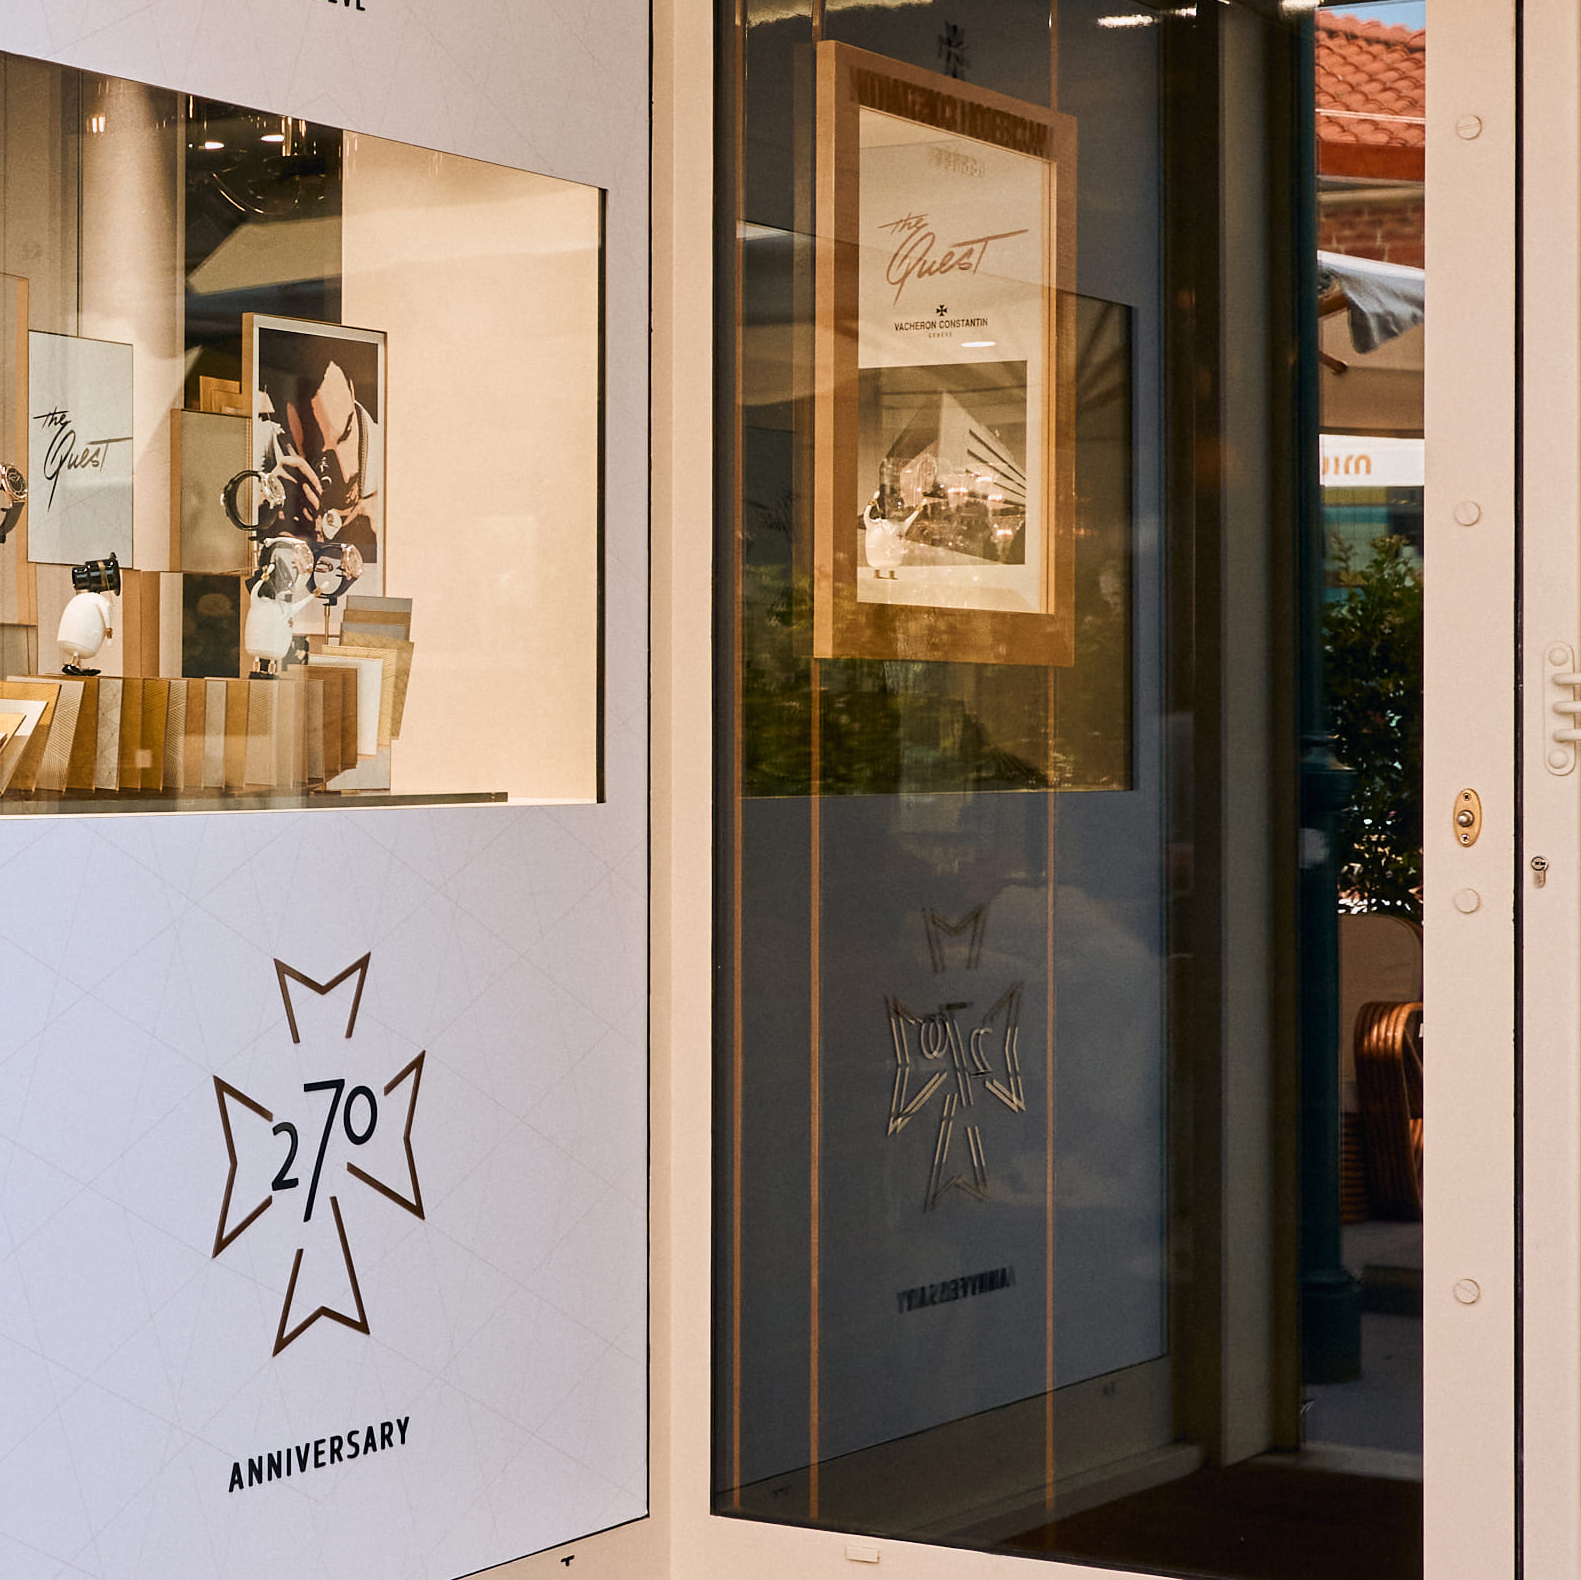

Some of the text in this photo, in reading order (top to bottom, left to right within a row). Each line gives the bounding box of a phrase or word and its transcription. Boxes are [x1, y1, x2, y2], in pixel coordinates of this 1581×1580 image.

[878, 212, 930, 235] the
[894, 318, 988, 331] VACHERON CONSTANTIN
[33, 406, 72, 429] the
[271, 1078, 378, 1223] 270
[229, 1416, 411, 1492] ANNIVERSARY
